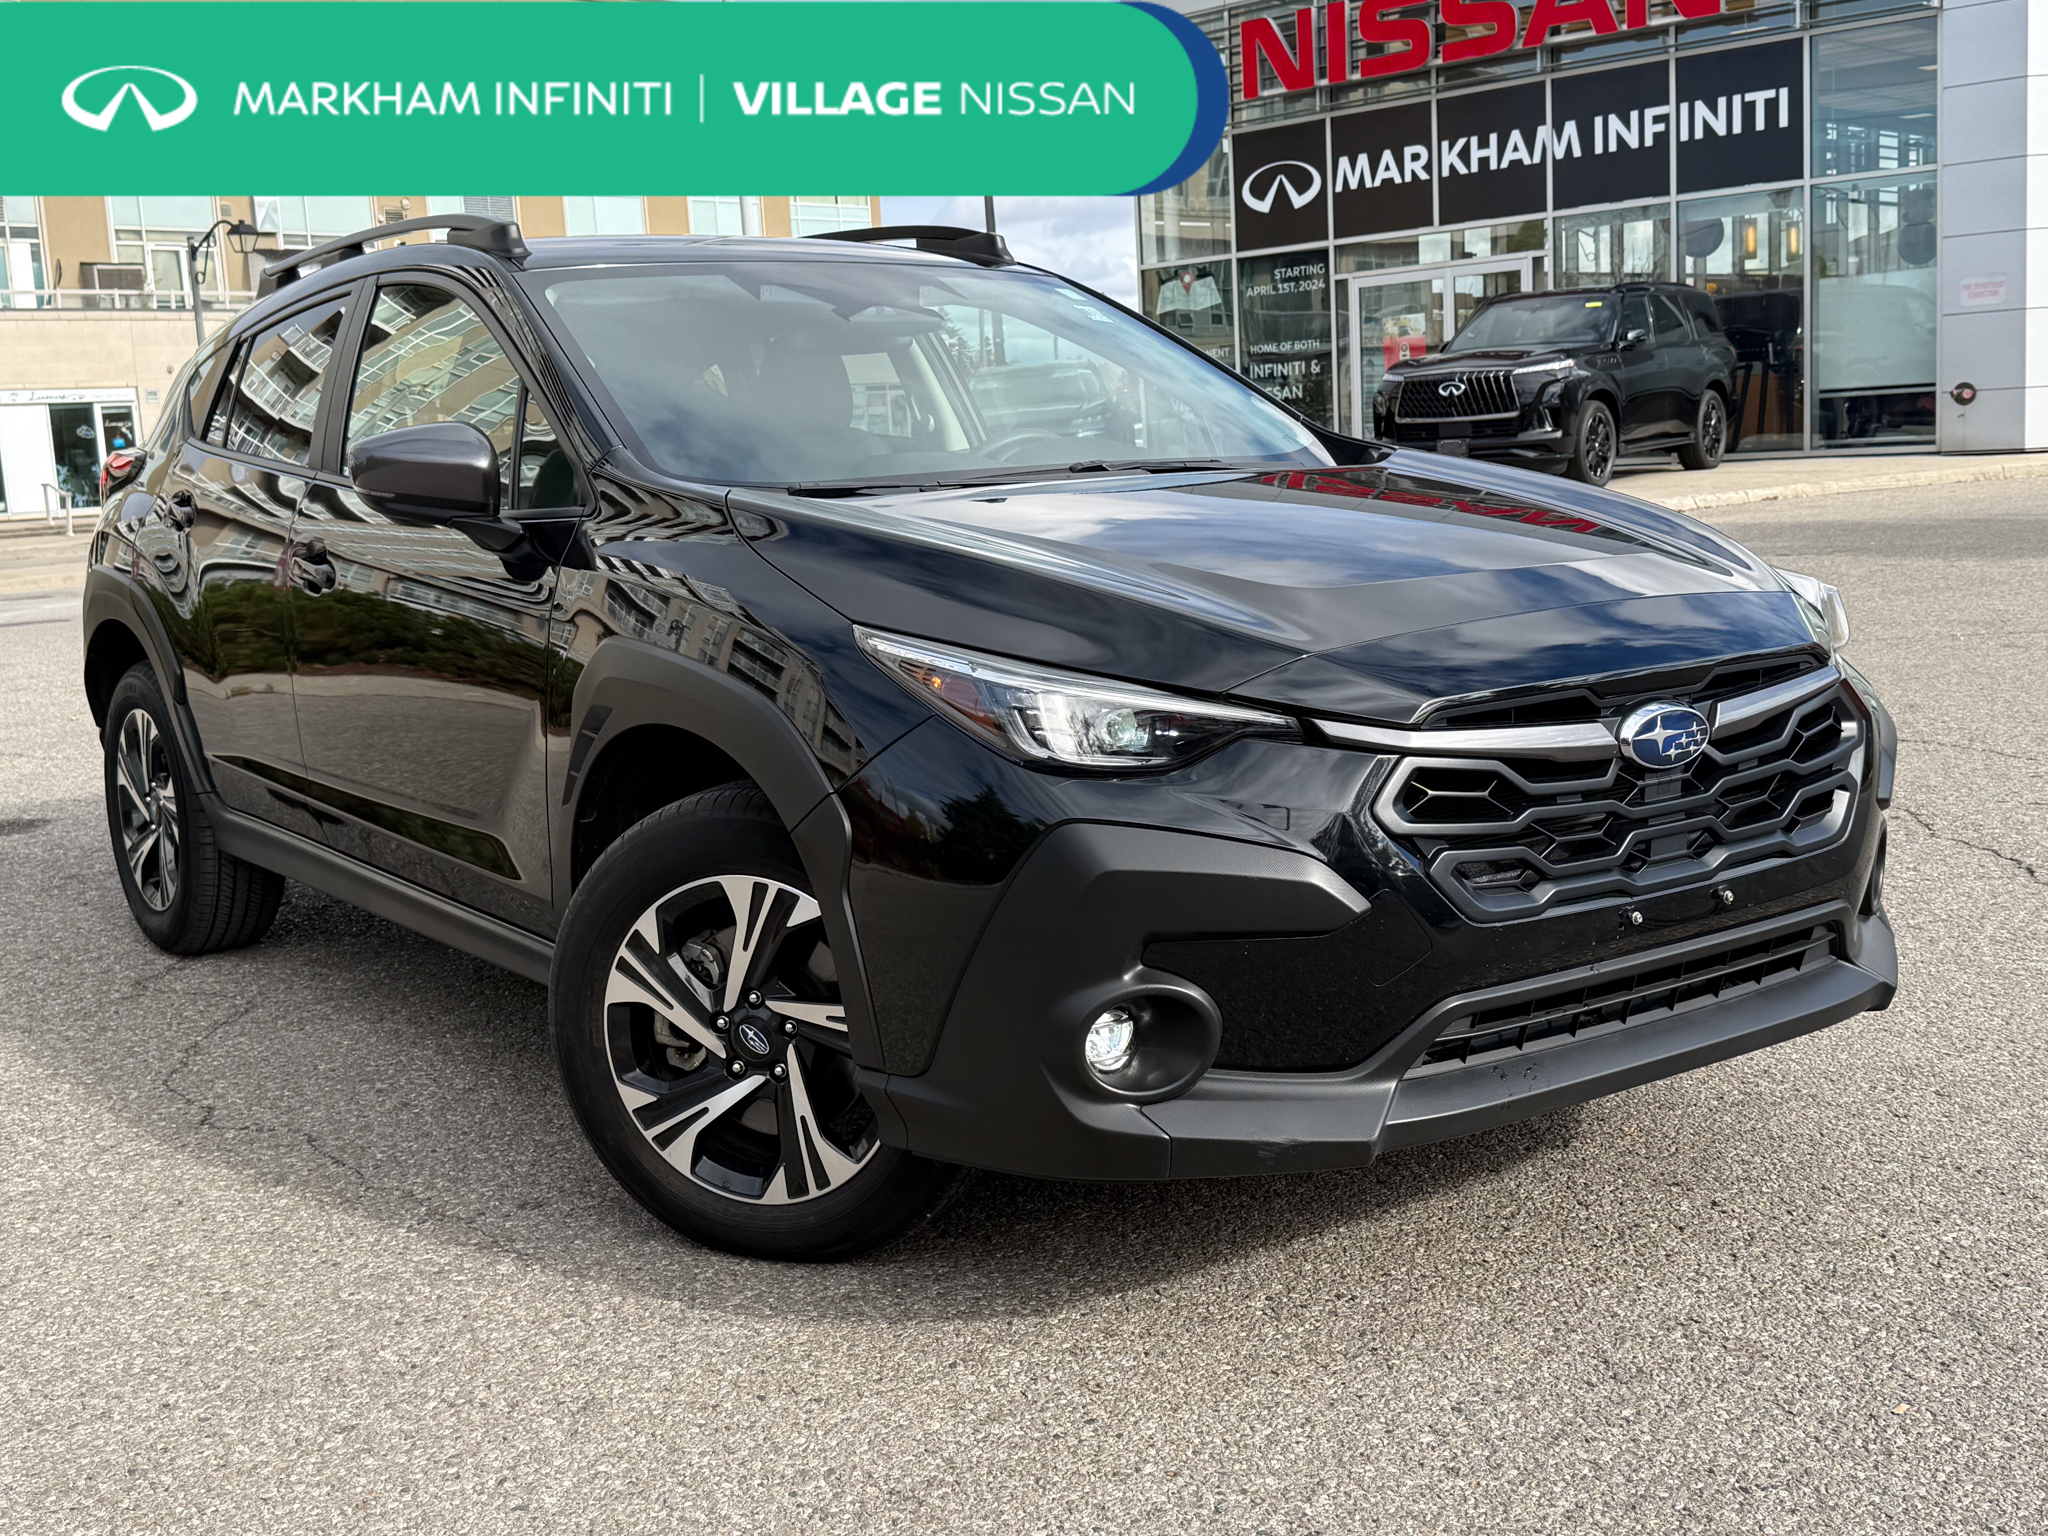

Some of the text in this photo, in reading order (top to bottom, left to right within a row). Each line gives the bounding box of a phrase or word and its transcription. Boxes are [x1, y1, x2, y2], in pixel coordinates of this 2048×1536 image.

[1334, 86, 1790, 193] MARKHAM INFINITI
[1274, 263, 1326, 280] STARTING
[1246, 283, 1277, 298] APRIL
[1298, 279, 1326, 292] 2024
[1250, 338, 1320, 355] HOME OF BOTH
[1249, 358, 1321, 380] INFINITI &
